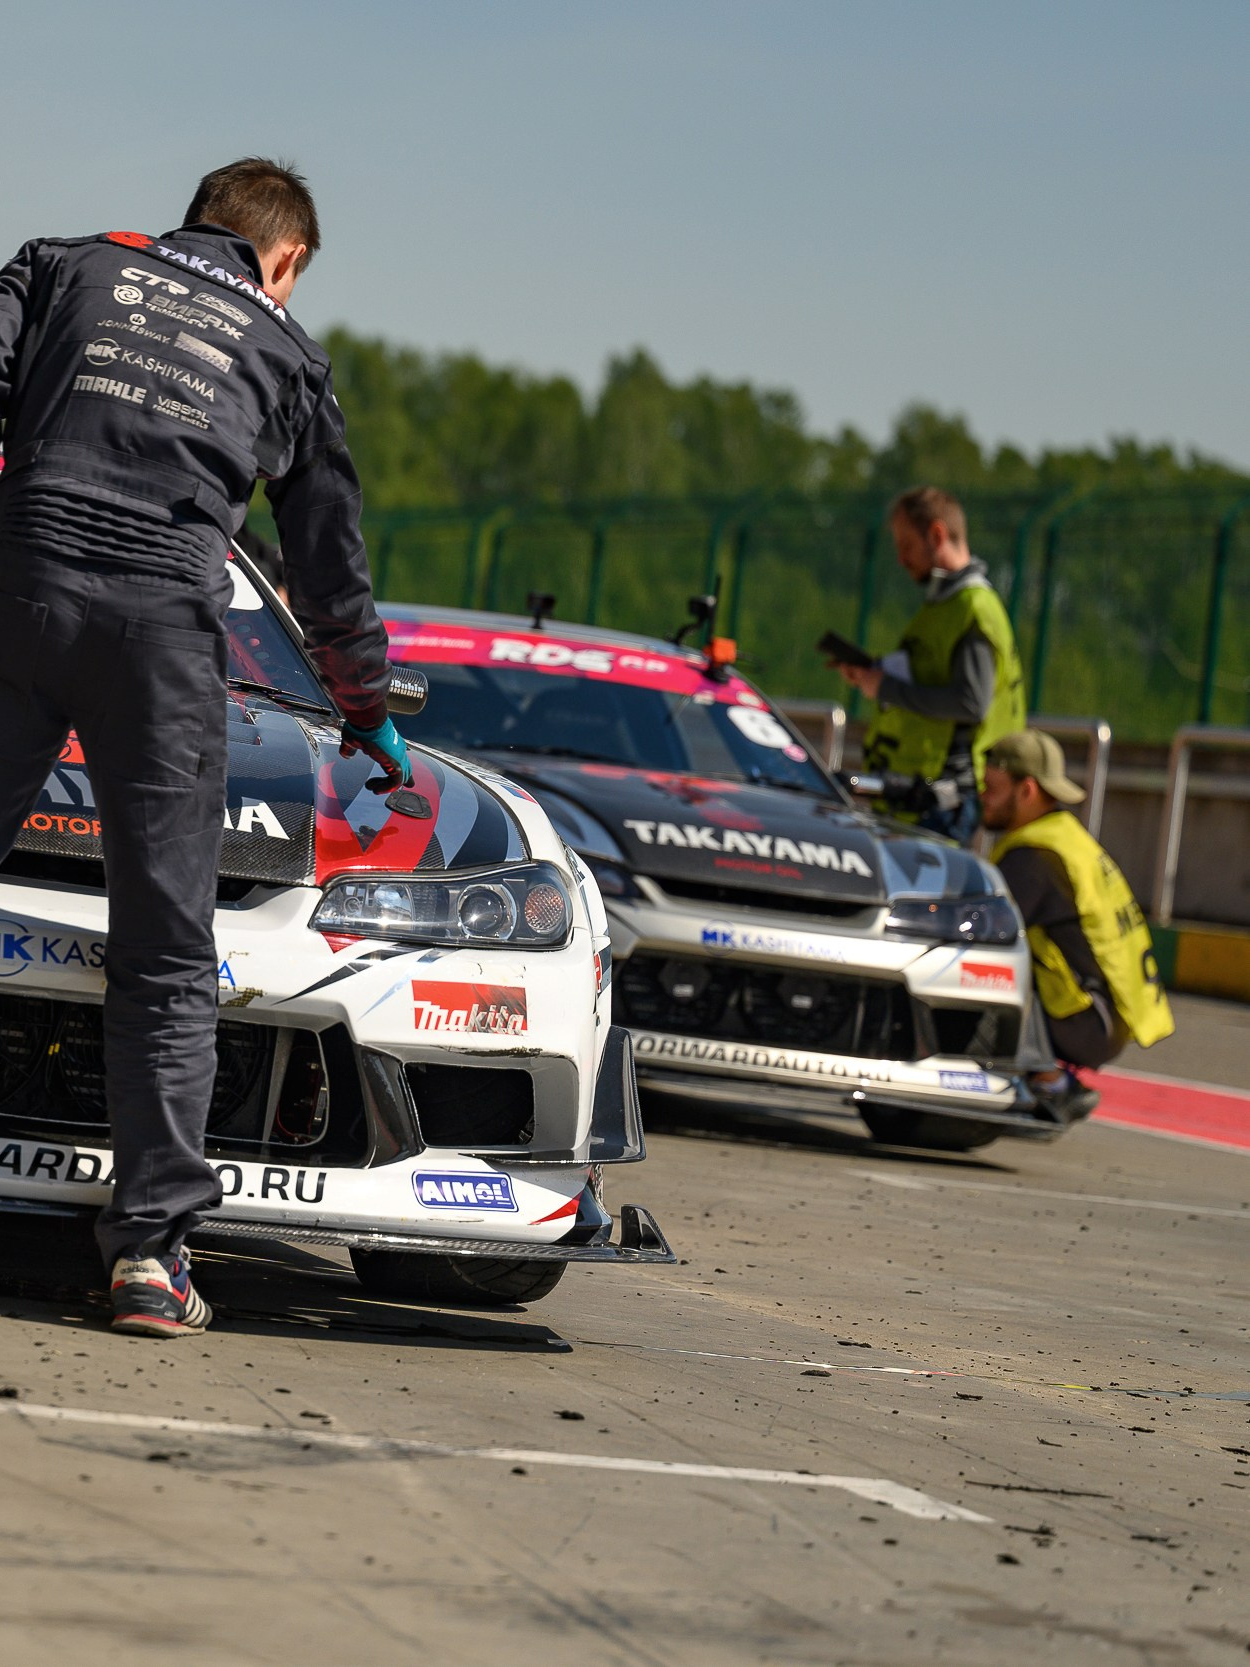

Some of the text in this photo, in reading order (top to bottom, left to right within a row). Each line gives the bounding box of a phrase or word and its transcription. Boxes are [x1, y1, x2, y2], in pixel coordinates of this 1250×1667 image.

[157, 245, 286, 322] TAKAYAMA
[73, 375, 147, 404] MAHLE
[84, 344, 215, 403] MK KASHIYAMA
[623, 819, 873, 878] TAKAYAMA
[423, 1180, 511, 1204] AIMOL
